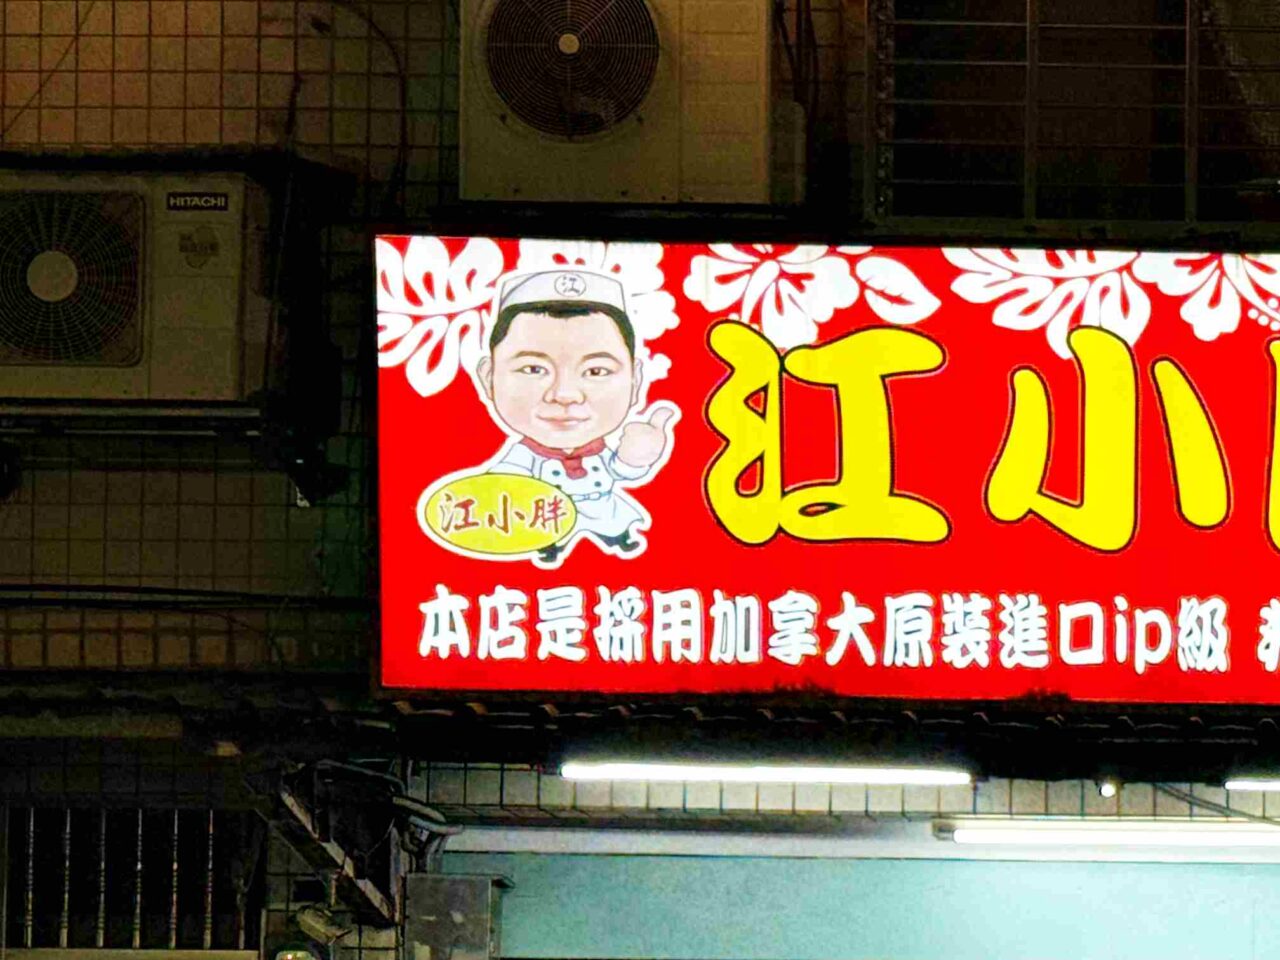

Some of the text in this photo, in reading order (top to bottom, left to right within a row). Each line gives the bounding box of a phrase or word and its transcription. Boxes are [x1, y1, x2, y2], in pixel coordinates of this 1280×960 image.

[169, 196, 226, 207] HITACHI
[440, 493, 567, 534] 江小胖
[418, 584, 1229, 674] 本店是採用加拿大原裝進口ip級
